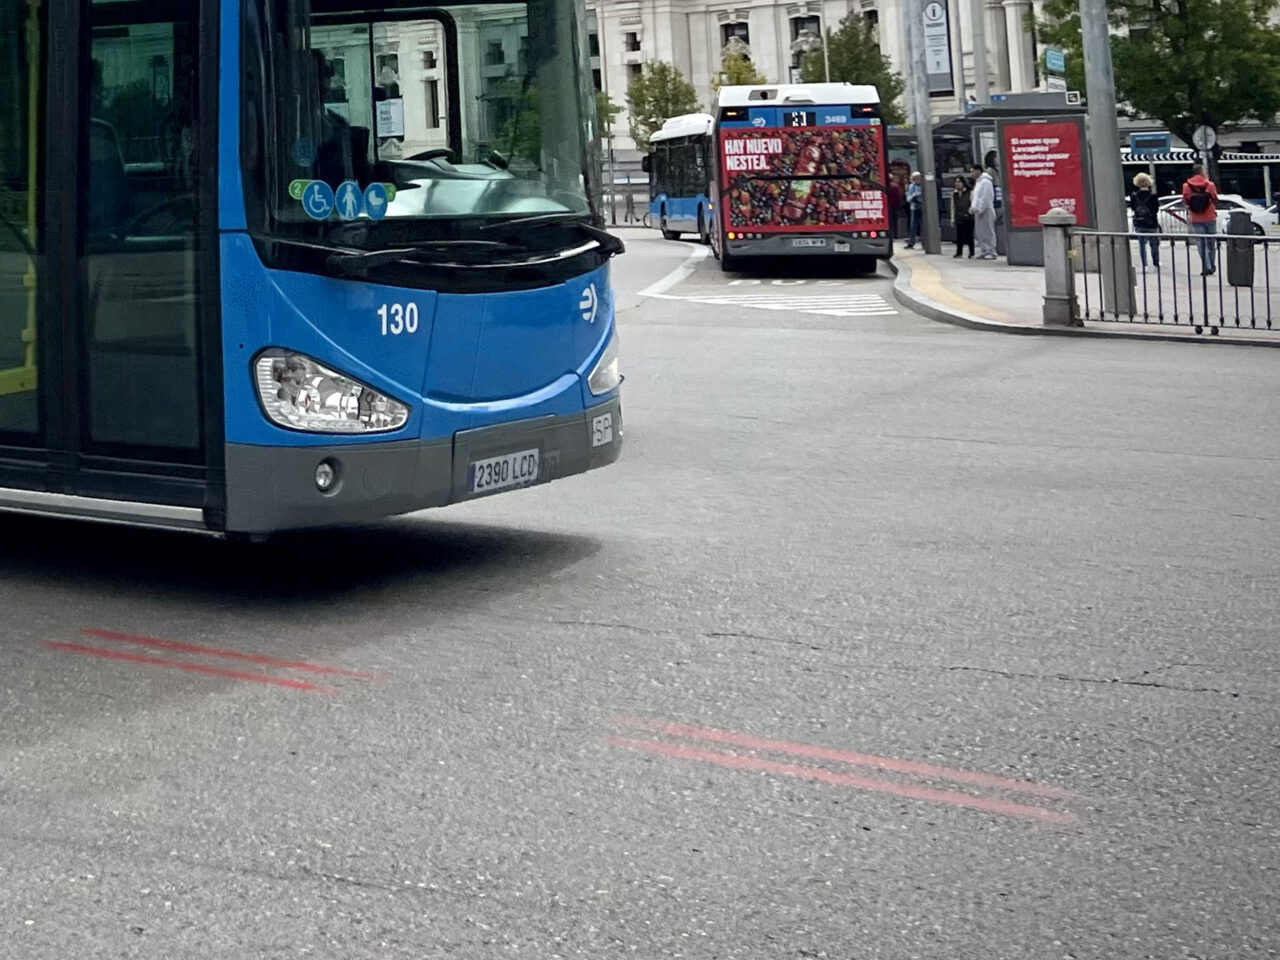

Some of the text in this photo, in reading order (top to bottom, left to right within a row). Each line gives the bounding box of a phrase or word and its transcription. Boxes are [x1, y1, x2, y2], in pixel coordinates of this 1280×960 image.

[725, 138, 782, 154] HAY NUEVO
[1043, 138, 1060, 146] que
[726, 155, 770, 171] NESTEA.
[1047, 153, 1070, 161] pasar
[377, 302, 419, 335] 130
[476, 453, 536, 489] 2390 LCD
